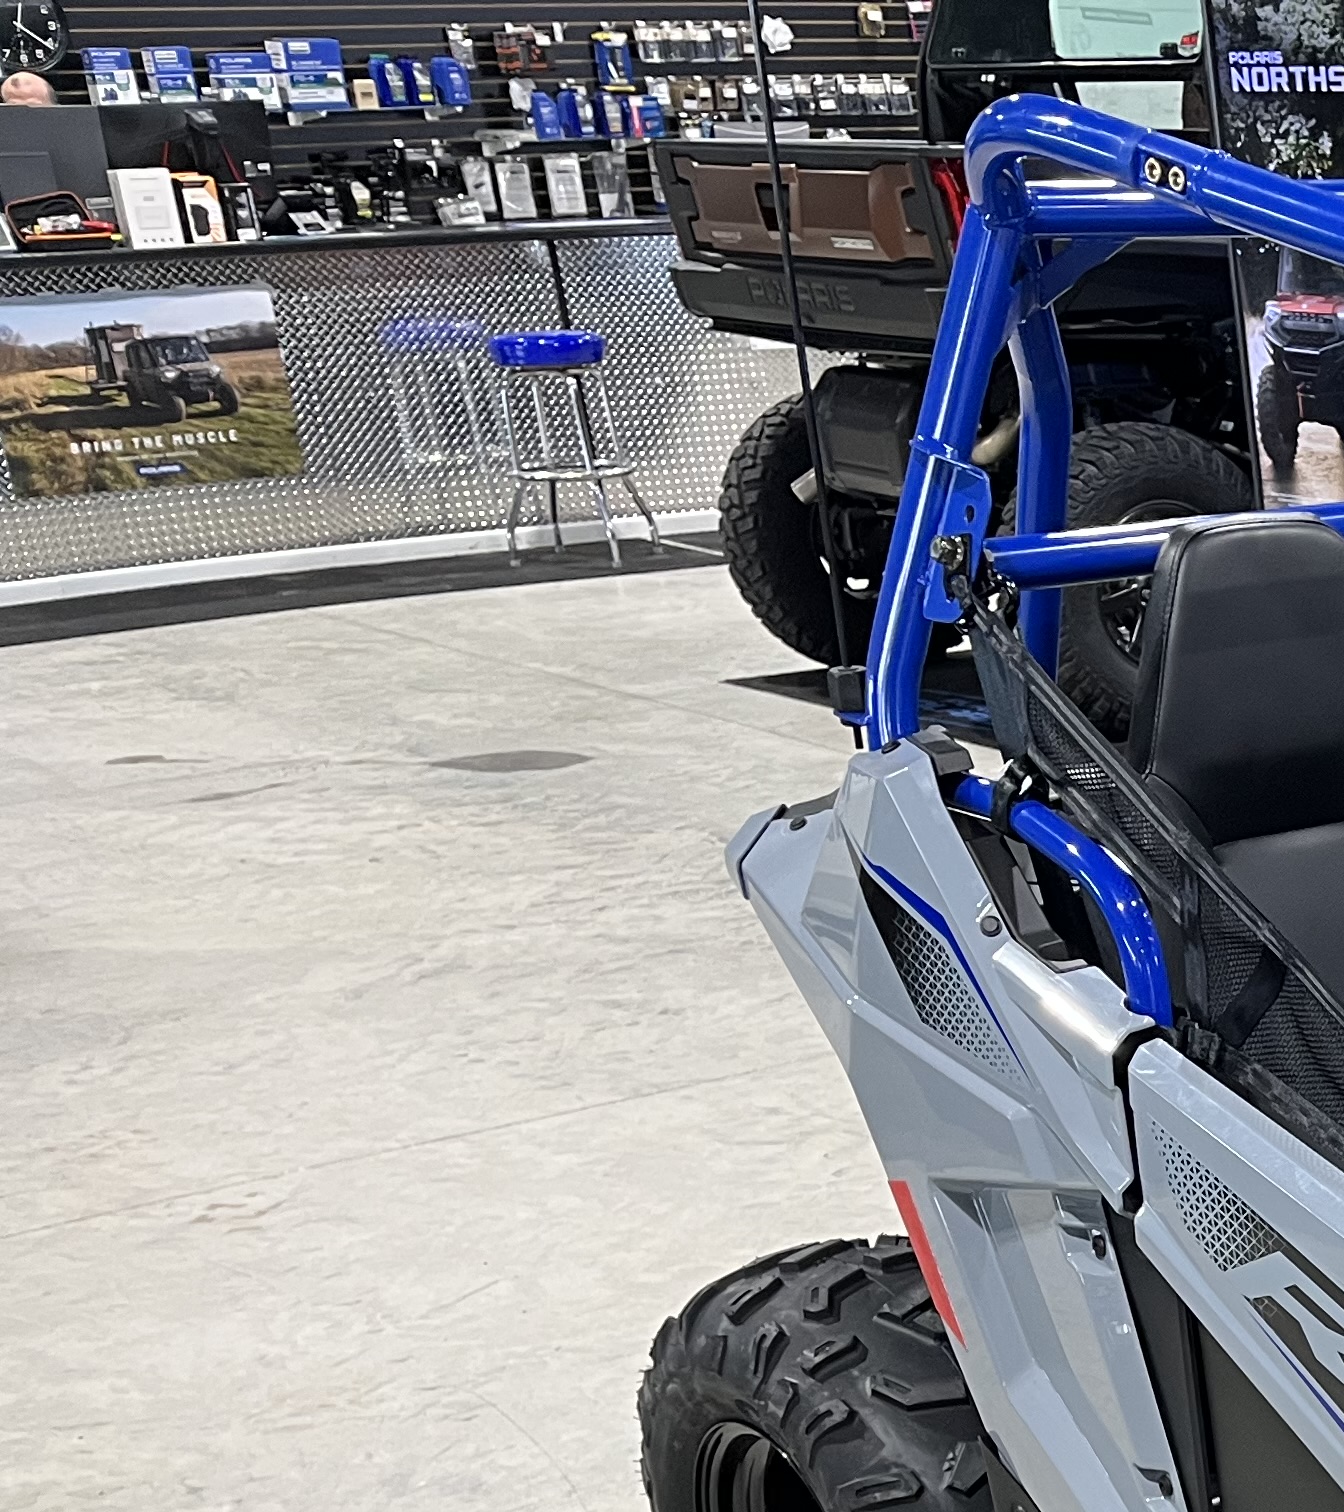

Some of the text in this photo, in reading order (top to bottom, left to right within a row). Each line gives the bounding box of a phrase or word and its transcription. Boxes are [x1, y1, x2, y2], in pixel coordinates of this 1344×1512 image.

[1228, 51, 1284, 64] POLARIS
[70, 429, 238, 454] BRING THE MUSCLE
